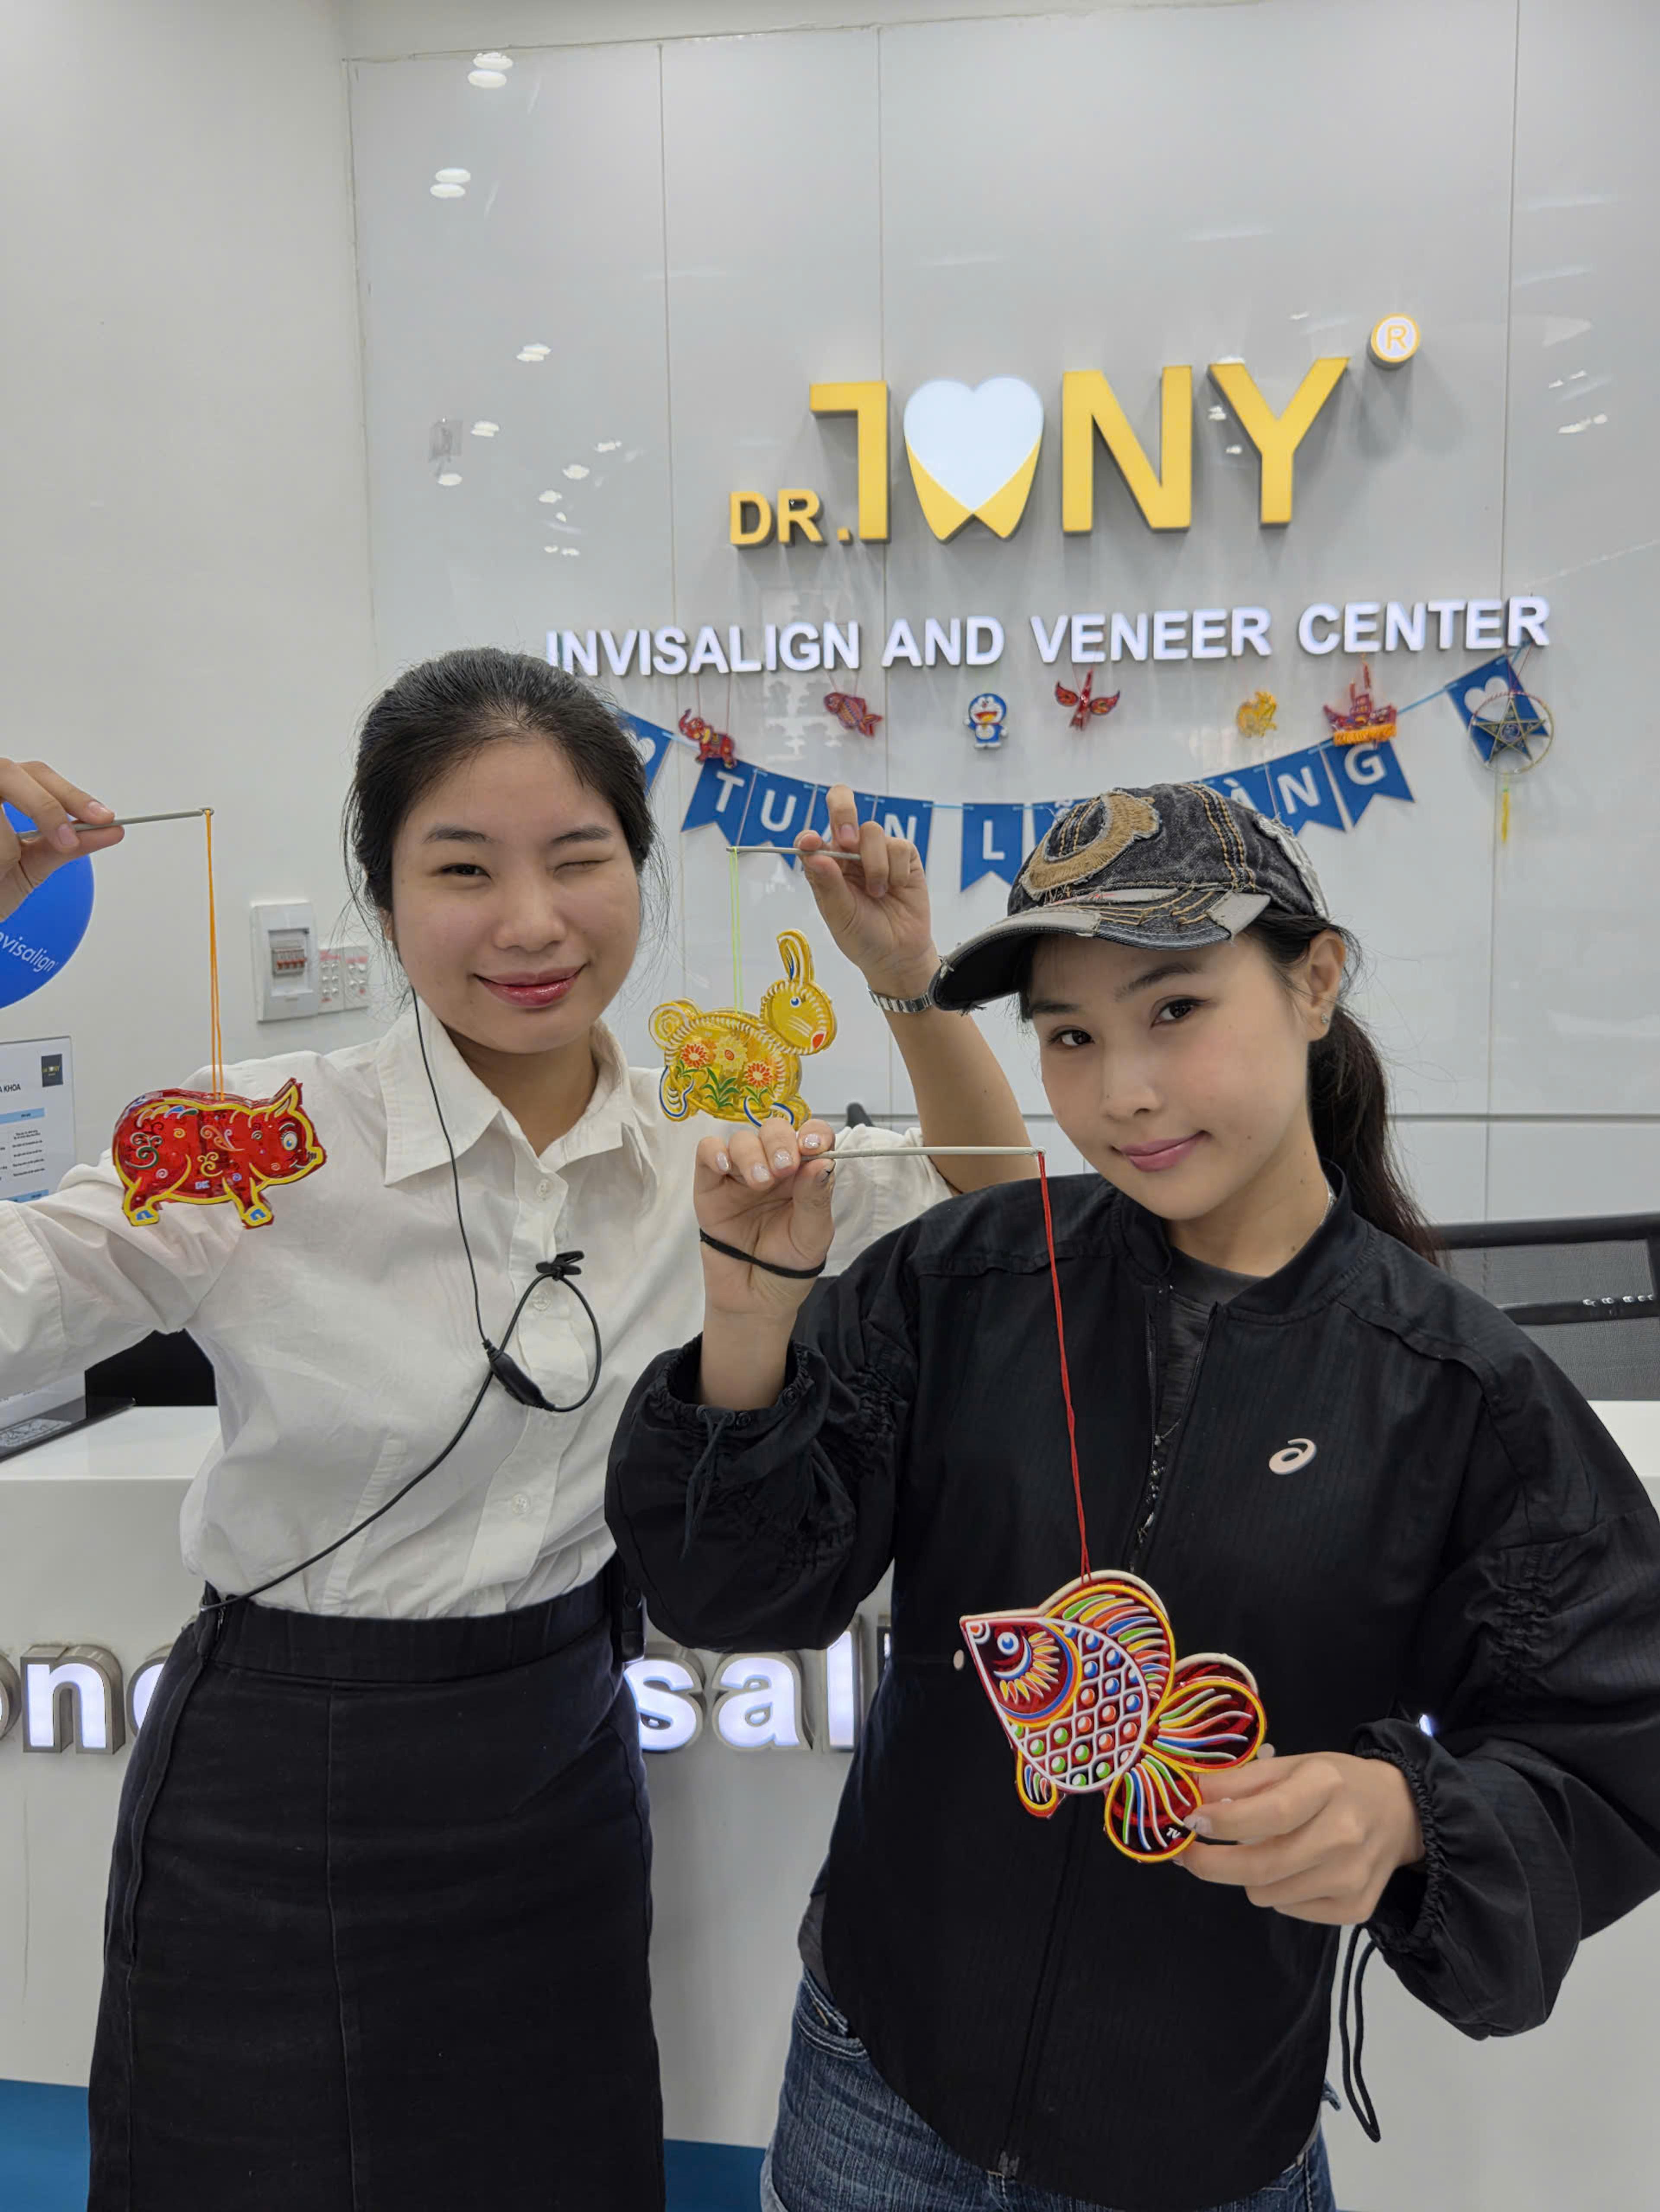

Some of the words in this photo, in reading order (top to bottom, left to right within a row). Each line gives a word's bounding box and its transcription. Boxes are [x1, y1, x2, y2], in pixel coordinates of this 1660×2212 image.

[730, 489, 850, 546] DR.
[546, 621, 859, 676] INVISALIGN
[881, 616, 1005, 667] AND
[1031, 606, 1271, 663] VENEER
[1298, 596, 1550, 655] CENTER
[715, 771, 917, 844] TUN
